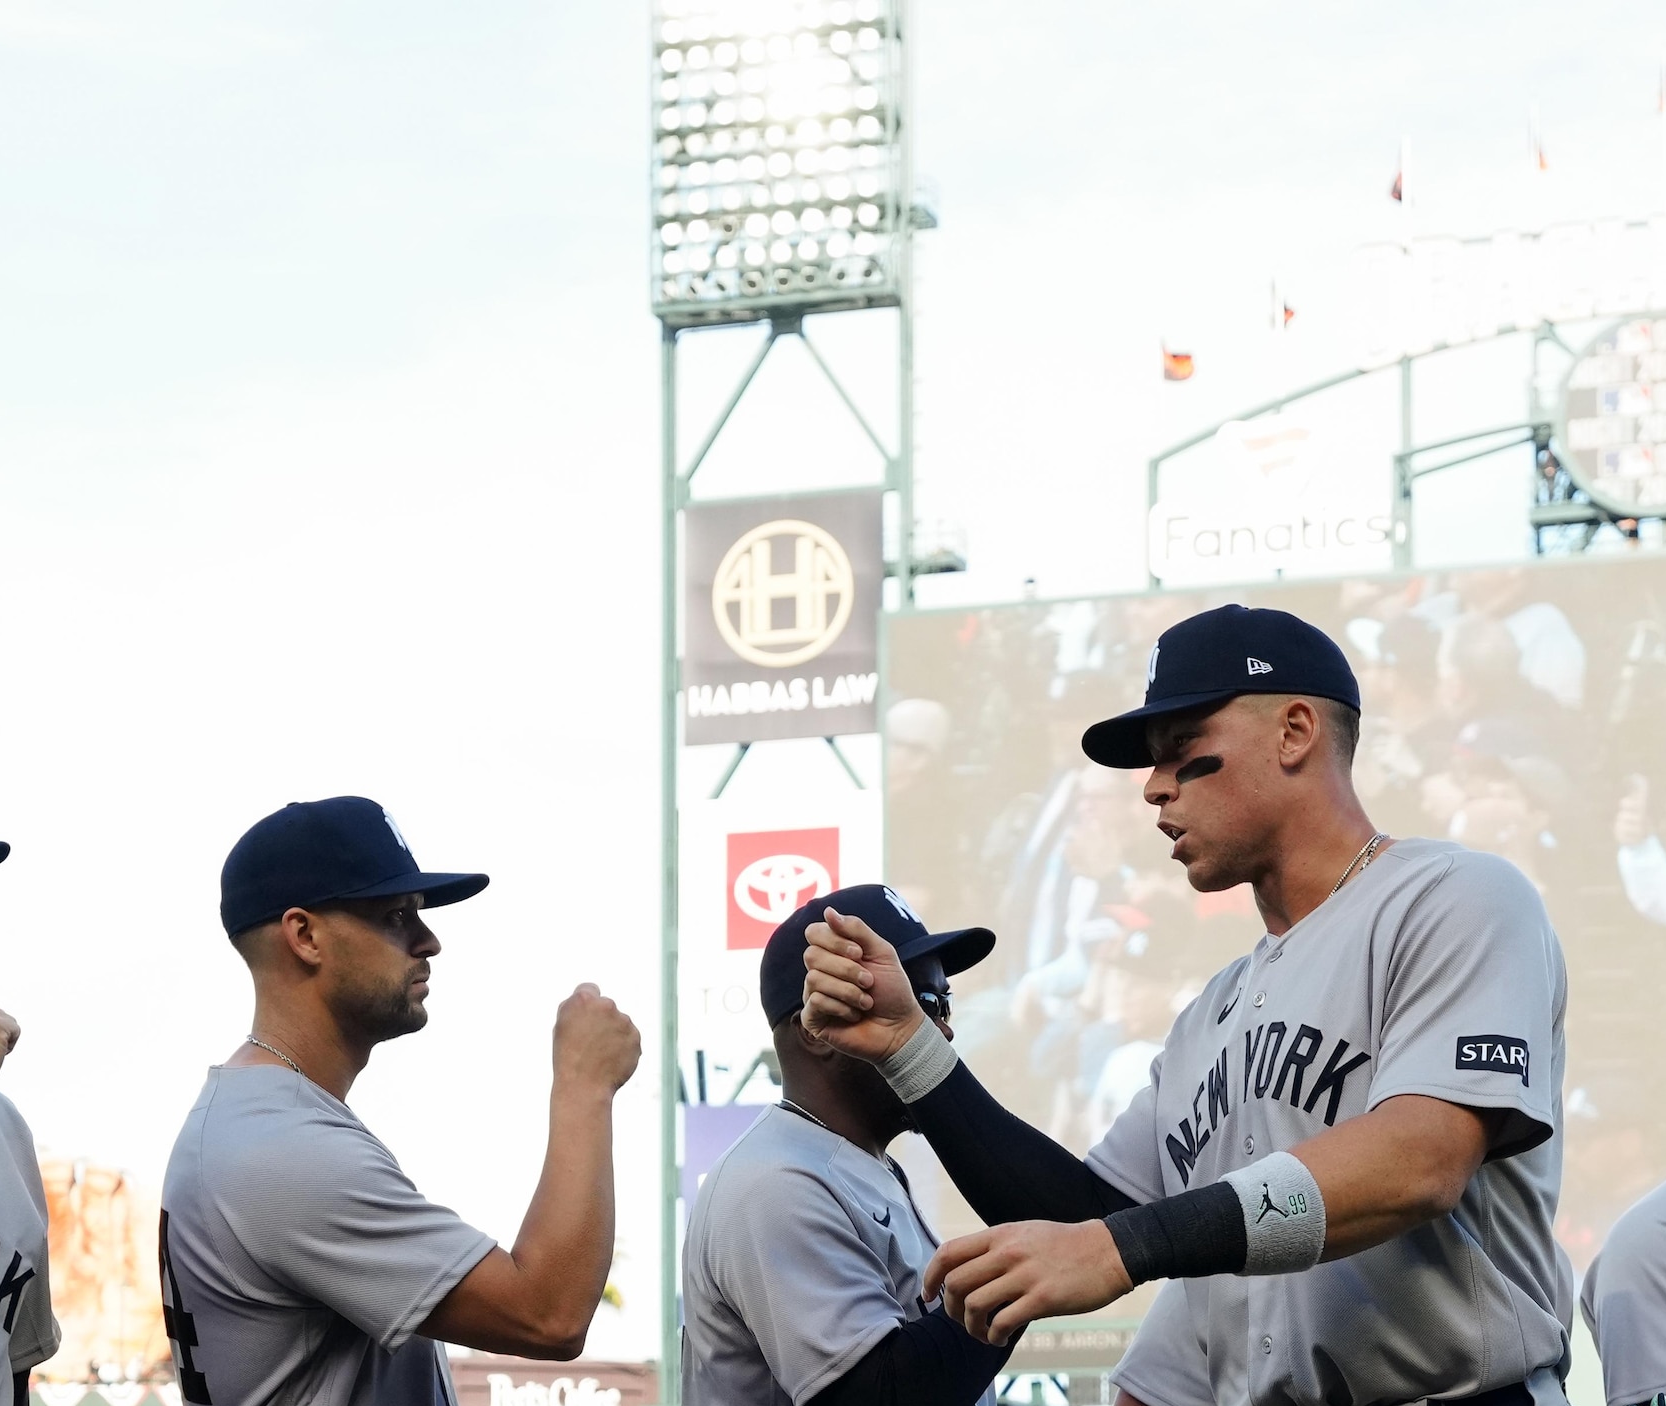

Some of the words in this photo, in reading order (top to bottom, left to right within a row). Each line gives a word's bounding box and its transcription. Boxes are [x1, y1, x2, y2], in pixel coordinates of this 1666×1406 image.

[1166, 511, 1390, 559] Fanatics
[811, 671, 879, 709] LAW
[1460, 1043, 1527, 1077] STAR
[1165, 1048, 1229, 1188] NEW
[1243, 1020, 1371, 1127] YORK
[1288, 1193, 1307, 1216] 99
